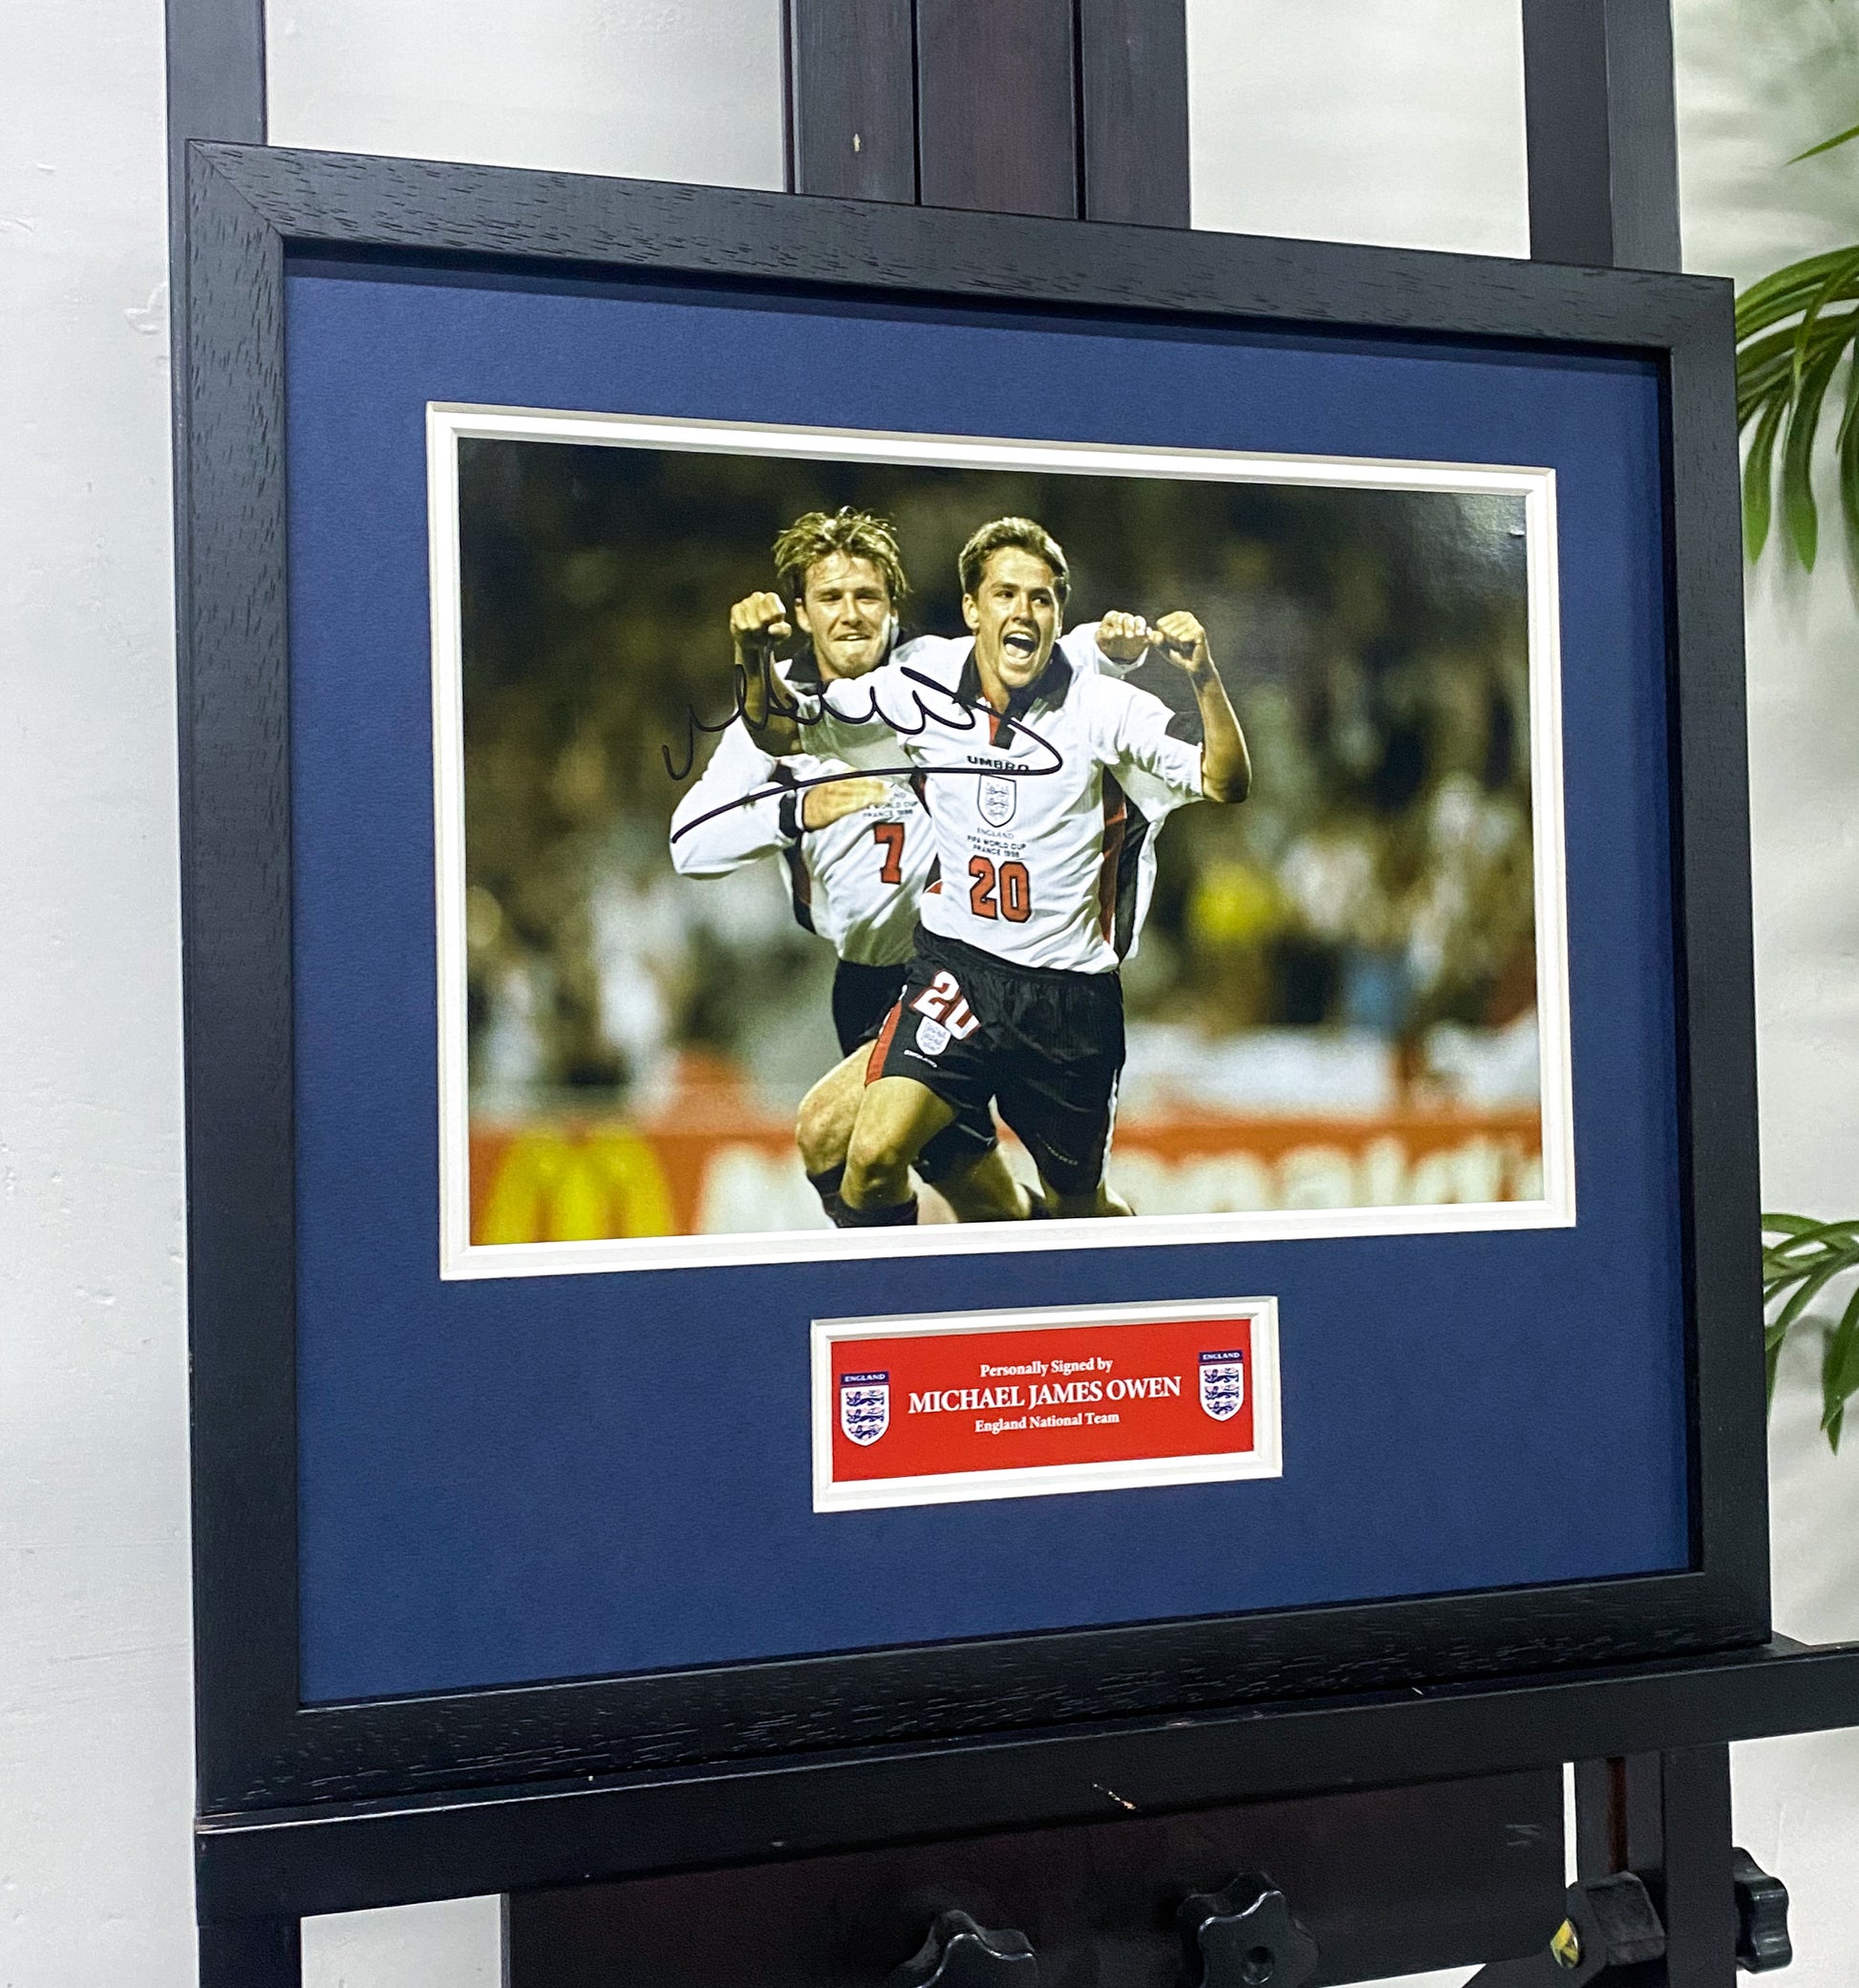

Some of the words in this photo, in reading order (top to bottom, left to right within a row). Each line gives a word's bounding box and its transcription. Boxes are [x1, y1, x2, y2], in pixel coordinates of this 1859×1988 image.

[976, 826, 1015, 840] ENGLAND
[873, 822, 905, 885] 7
[972, 844, 1001, 857] FRANCE
[983, 839, 1009, 849] WORLD
[1010, 843, 1027, 851] CUP
[969, 854, 1032, 924] 20
[1202, 1352, 1240, 1360] ENGLAND
[979, 1360, 1049, 1378] Personally
[1050, 1357, 1095, 1376] Signed
[1096, 1357, 1113, 1373] by
[844, 1373, 886, 1382] ENGLAND
[908, 1385, 1025, 1414] MICHAEL
[1027, 1380, 1103, 1410] JAMES
[1105, 1376, 1182, 1400] OWEN
[974, 1416, 1027, 1435] England
[1029, 1413, 1082, 1428] National
[1084, 1412, 1120, 1425] Team
